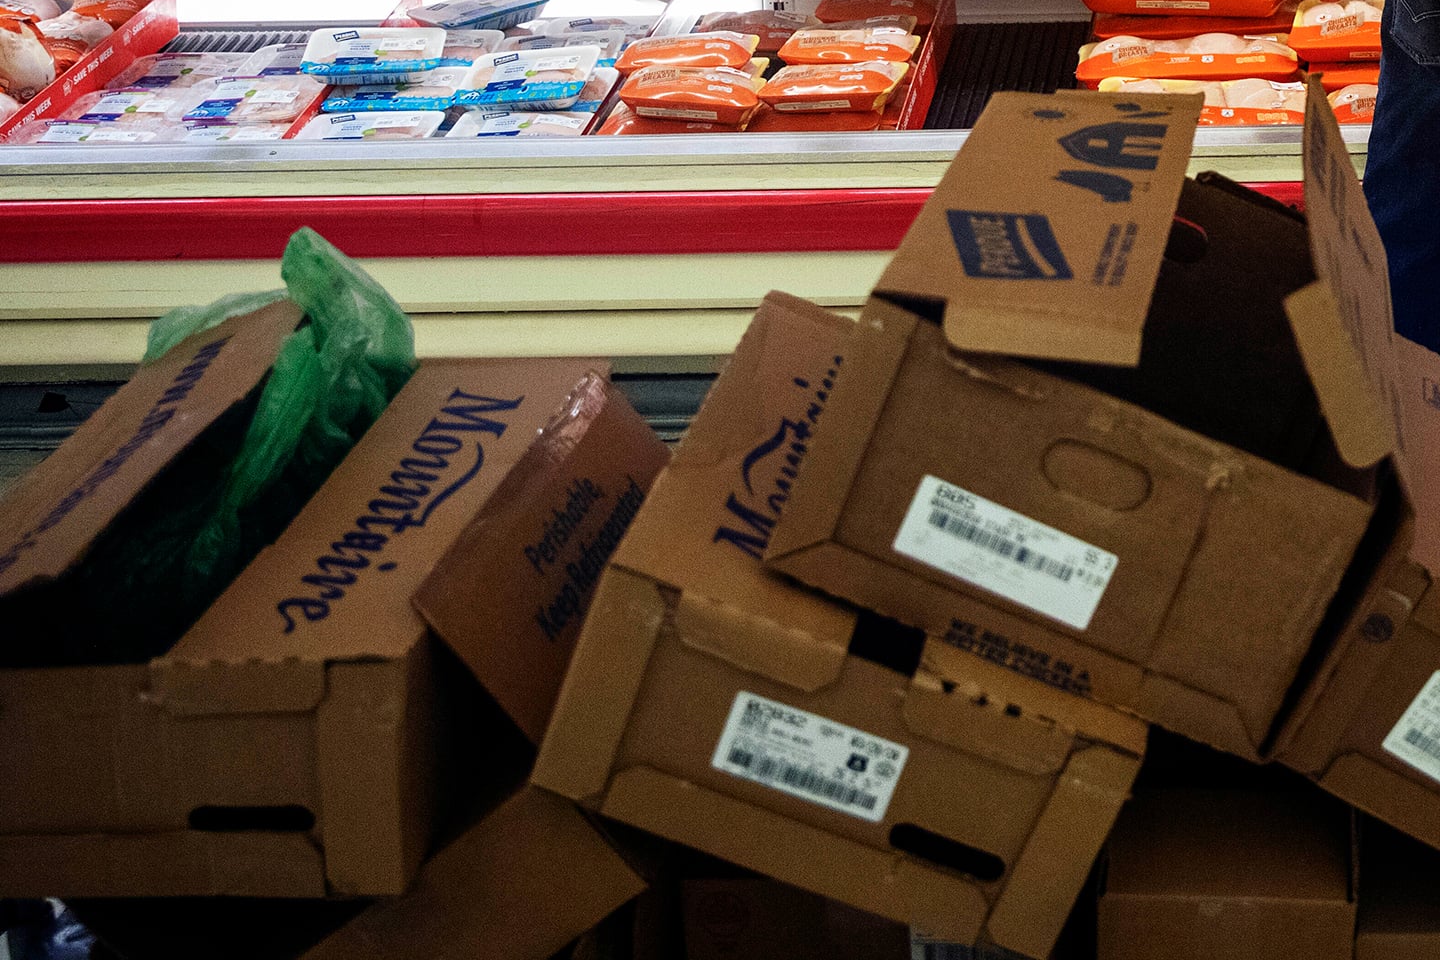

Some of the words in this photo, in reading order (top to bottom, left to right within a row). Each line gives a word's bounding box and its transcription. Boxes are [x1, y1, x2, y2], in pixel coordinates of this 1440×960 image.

[333, 30, 360, 42] PERDUE
[71, 66, 89, 87] SAVE
[98, 46, 115, 69] WEEK
[493, 53, 519, 66] PERDUE
[34, 98, 53, 118] WEEK
[276, 386, 527, 635] Mountaire
